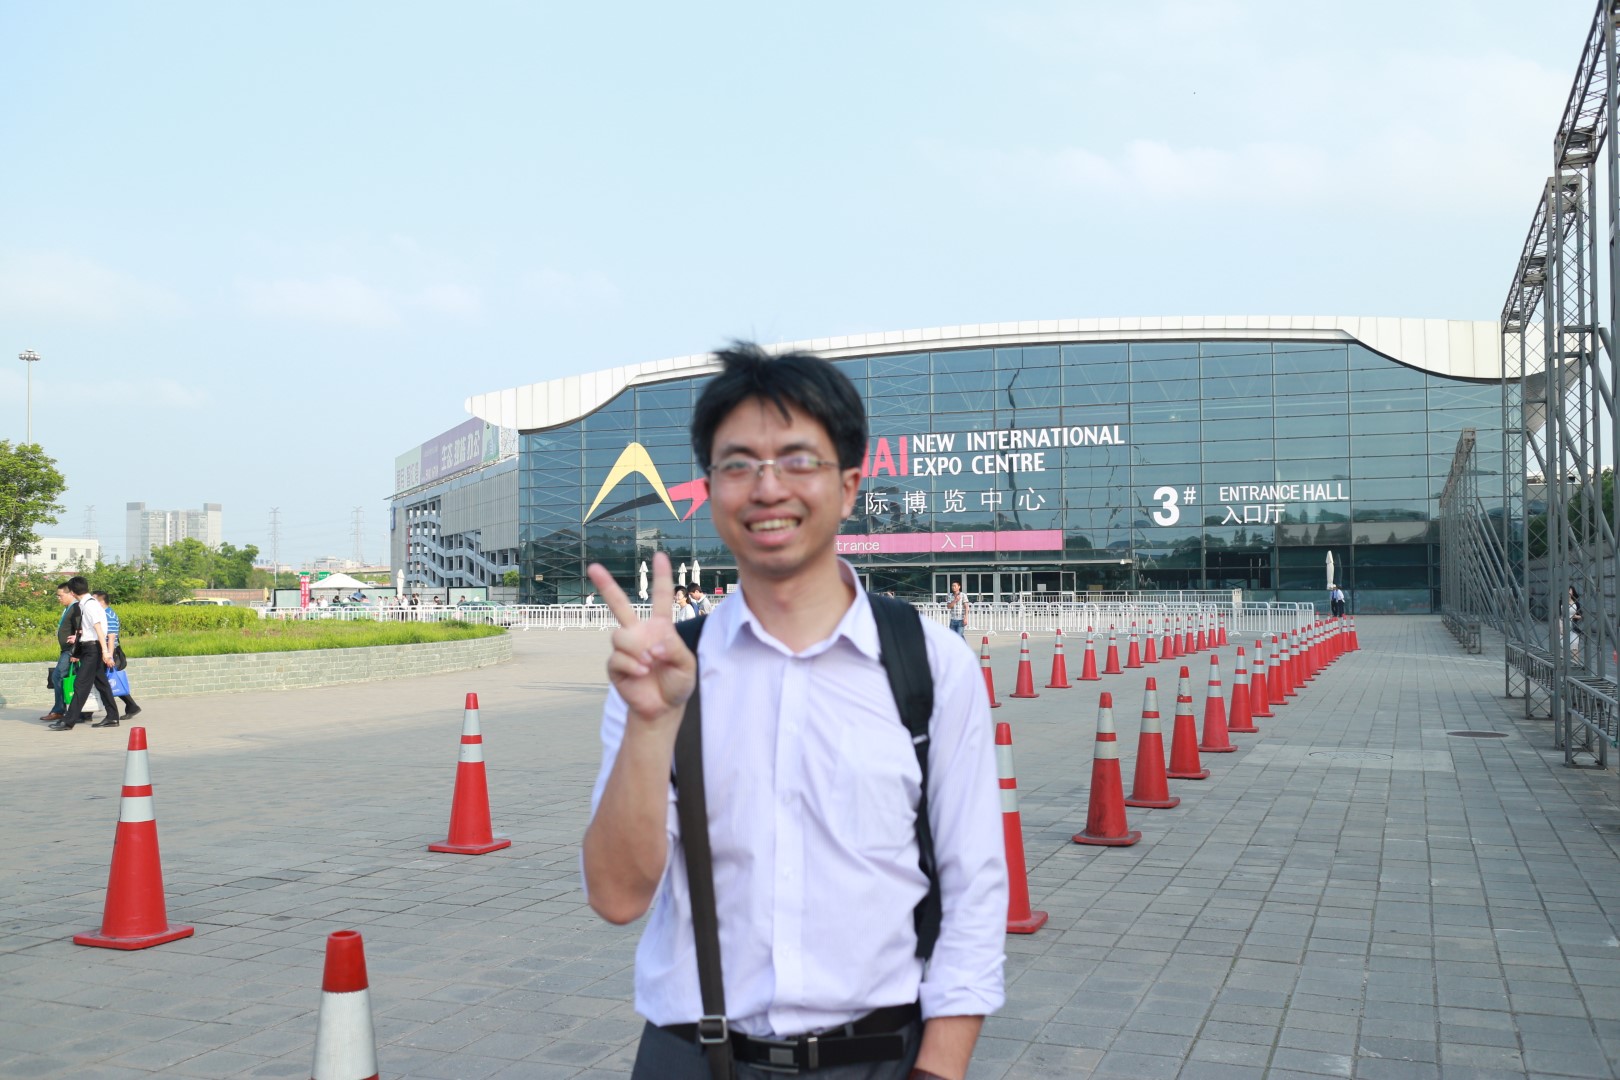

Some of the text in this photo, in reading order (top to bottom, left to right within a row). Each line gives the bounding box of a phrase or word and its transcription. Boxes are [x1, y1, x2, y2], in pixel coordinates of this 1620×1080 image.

[913, 425, 1125, 453] NEW INTERNATIONAL
[913, 452, 1046, 477] EXPO CENTRE
[865, 487, 1046, 515] 际博览中心
[1219, 483, 1350, 502] ENTRANCE HALL
[1221, 503, 1286, 525] 入口厅
[941, 534, 975, 549] 入口
